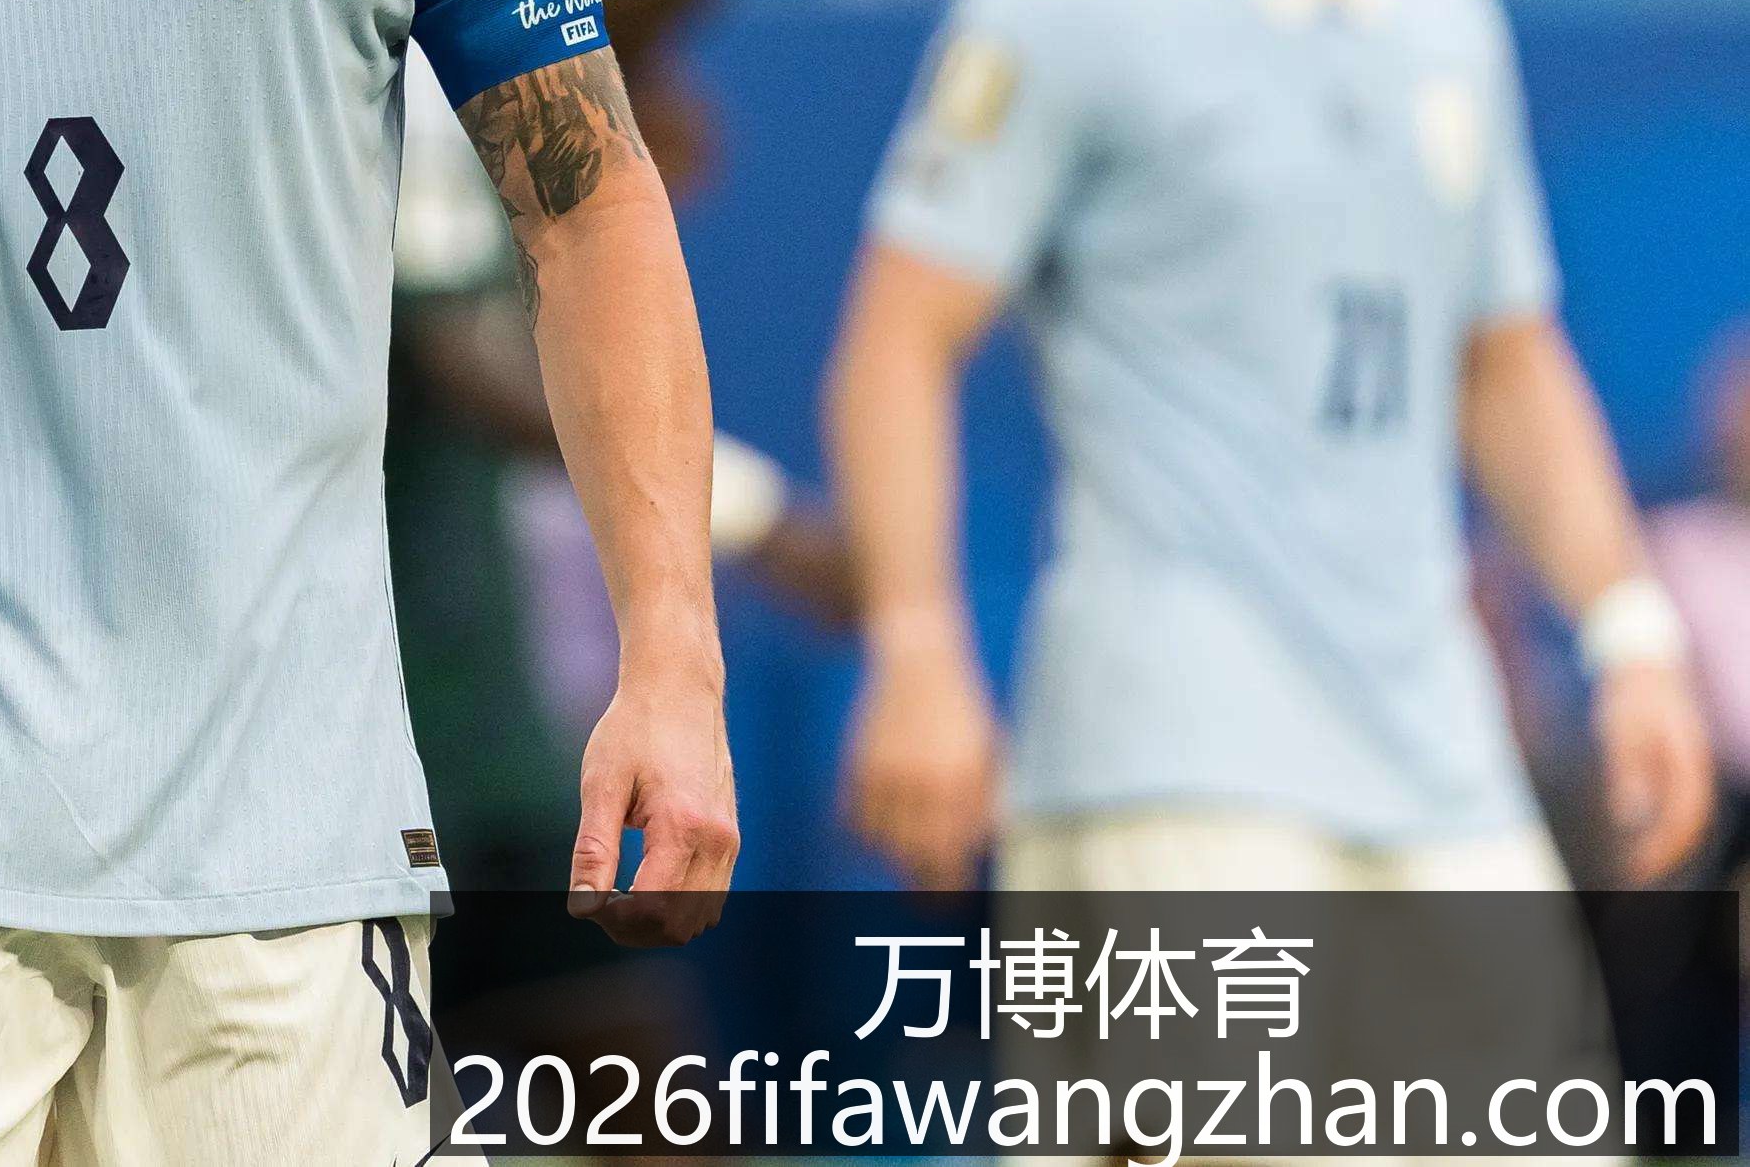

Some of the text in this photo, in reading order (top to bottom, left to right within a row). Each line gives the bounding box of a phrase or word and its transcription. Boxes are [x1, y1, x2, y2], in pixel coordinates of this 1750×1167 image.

[566, 21, 596, 40] FIFA
[24, 116, 130, 331] 8
[362, 917, 432, 1108] 8
